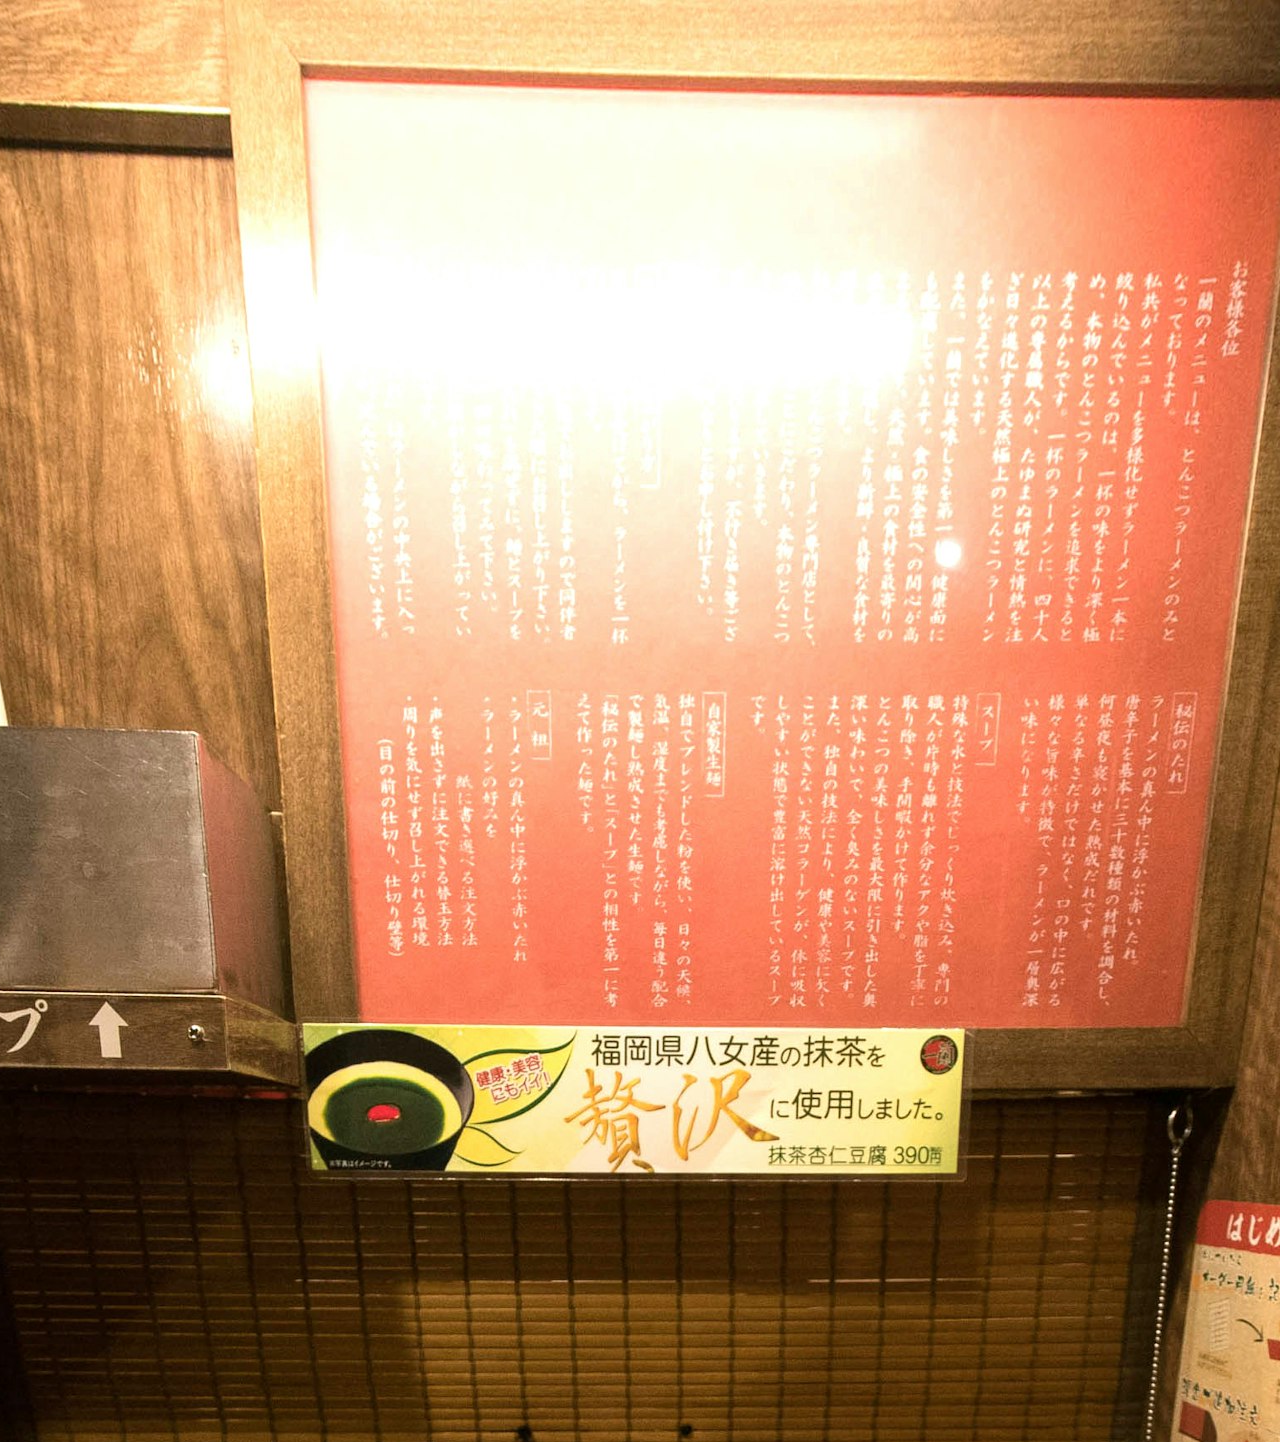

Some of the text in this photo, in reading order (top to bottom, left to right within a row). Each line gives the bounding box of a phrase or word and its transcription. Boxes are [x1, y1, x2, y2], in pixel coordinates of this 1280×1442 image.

[1163, 273, 1190, 415] なっております。
[1220, 260, 1249, 357] お客様各位
[1109, 273, 1162, 641] 私共がメニューを多様化せずラーメン一本に
[705, 703, 722, 787] 自家製生麺
[751, 695, 767, 735] です。
[979, 705, 995, 751] スープ
[1168, 703, 1193, 784] 秘伝のたれ
[576, 693, 594, 833] えて作った麺です。
[1017, 697, 1039, 823] い味になります。
[455, 775, 479, 946] 紙に書き選べる注文方法
[475, 1053, 543, 1089] 健康・美容
[491, 1070, 552, 1102] にもイイ!
[591, 1033, 887, 1068] 福岡県八女産の抹茶を
[564, 1068, 781, 1174] 贅沢
[770, 1088, 944, 1121] に使用しました。
[768, 1145, 887, 1166] 抹茶杏仁豆腐
